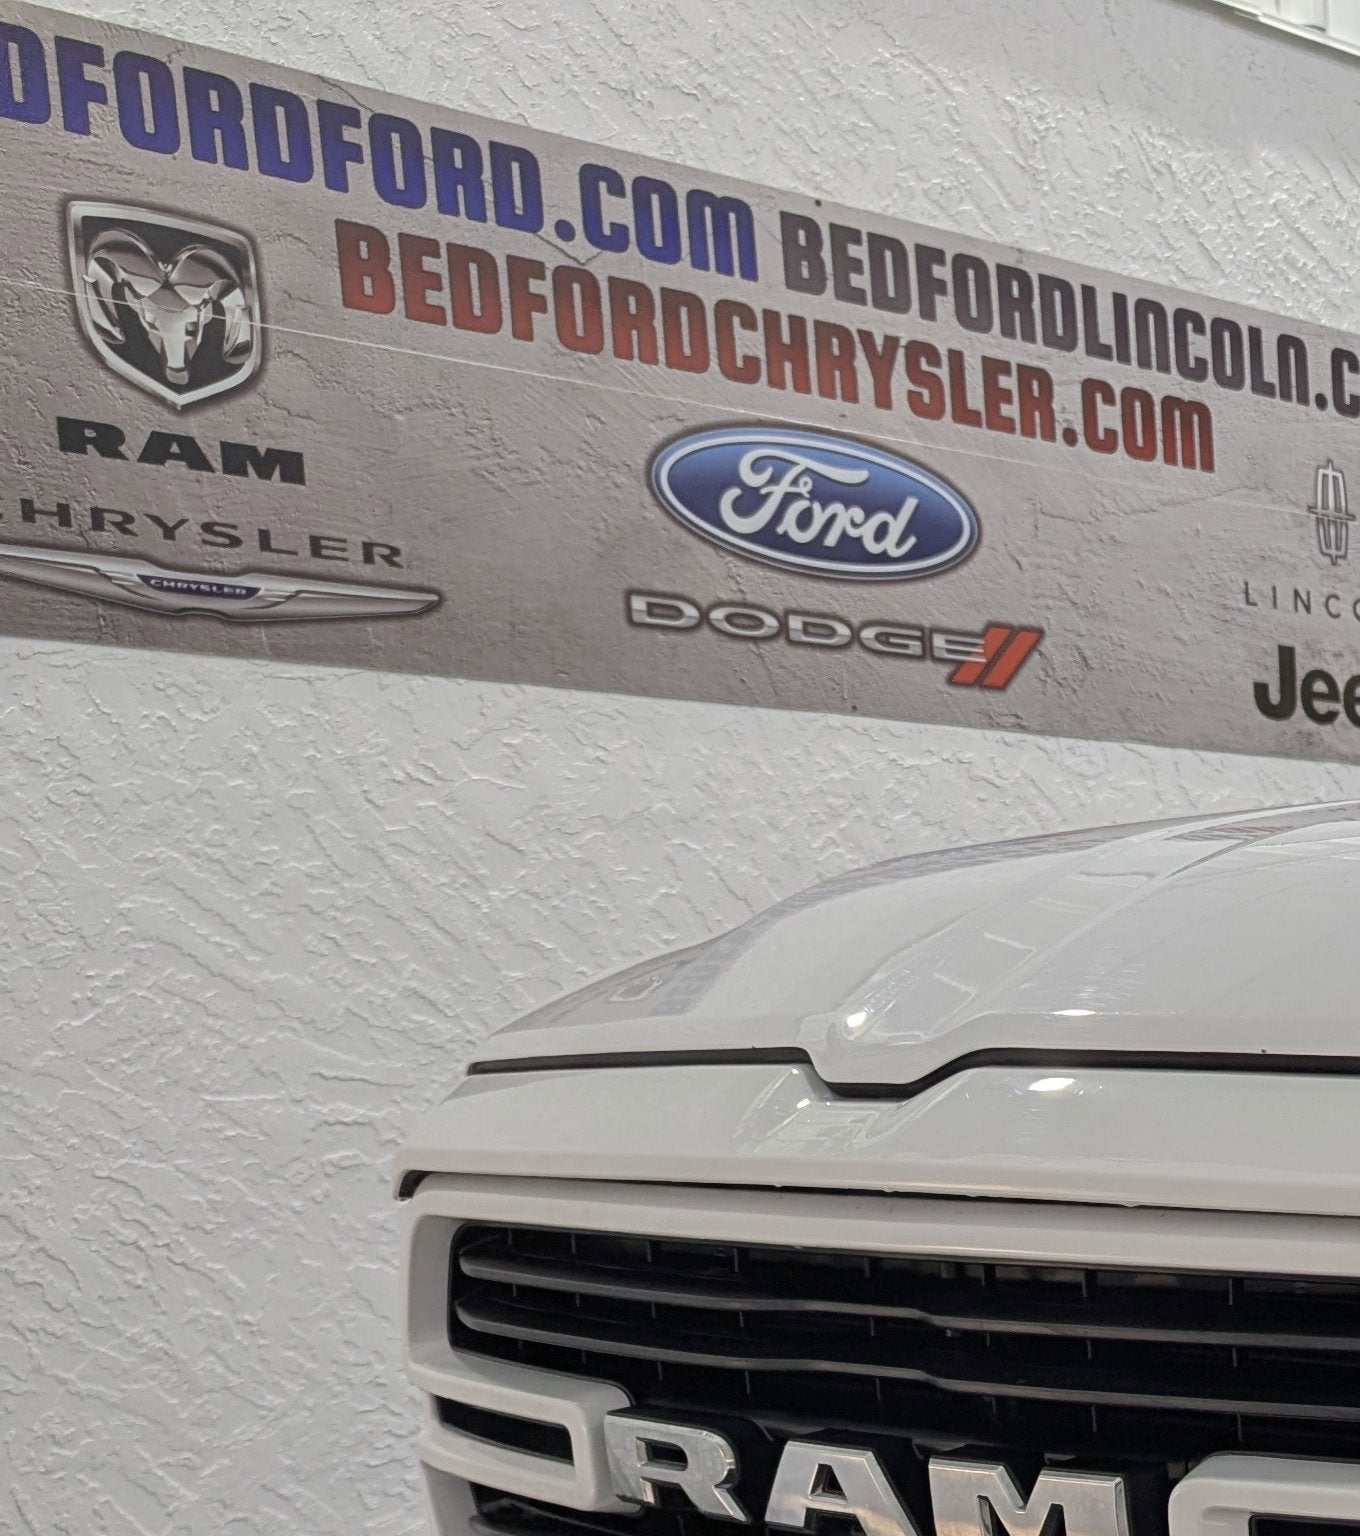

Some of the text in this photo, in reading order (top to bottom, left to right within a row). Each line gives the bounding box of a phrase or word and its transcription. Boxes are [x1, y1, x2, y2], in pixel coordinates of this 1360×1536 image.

[0, 22, 759, 282] DFORDFORD.COM
[334, 217, 1216, 474] BEDFORDCHRYSLER.COM
[56, 416, 308, 486] RAM
[0, 497, 404, 569] HRYSLER
[719, 448, 919, 559] Ford
[151, 579, 247, 595] CHRYSLER
[630, 596, 988, 664] DODGE
